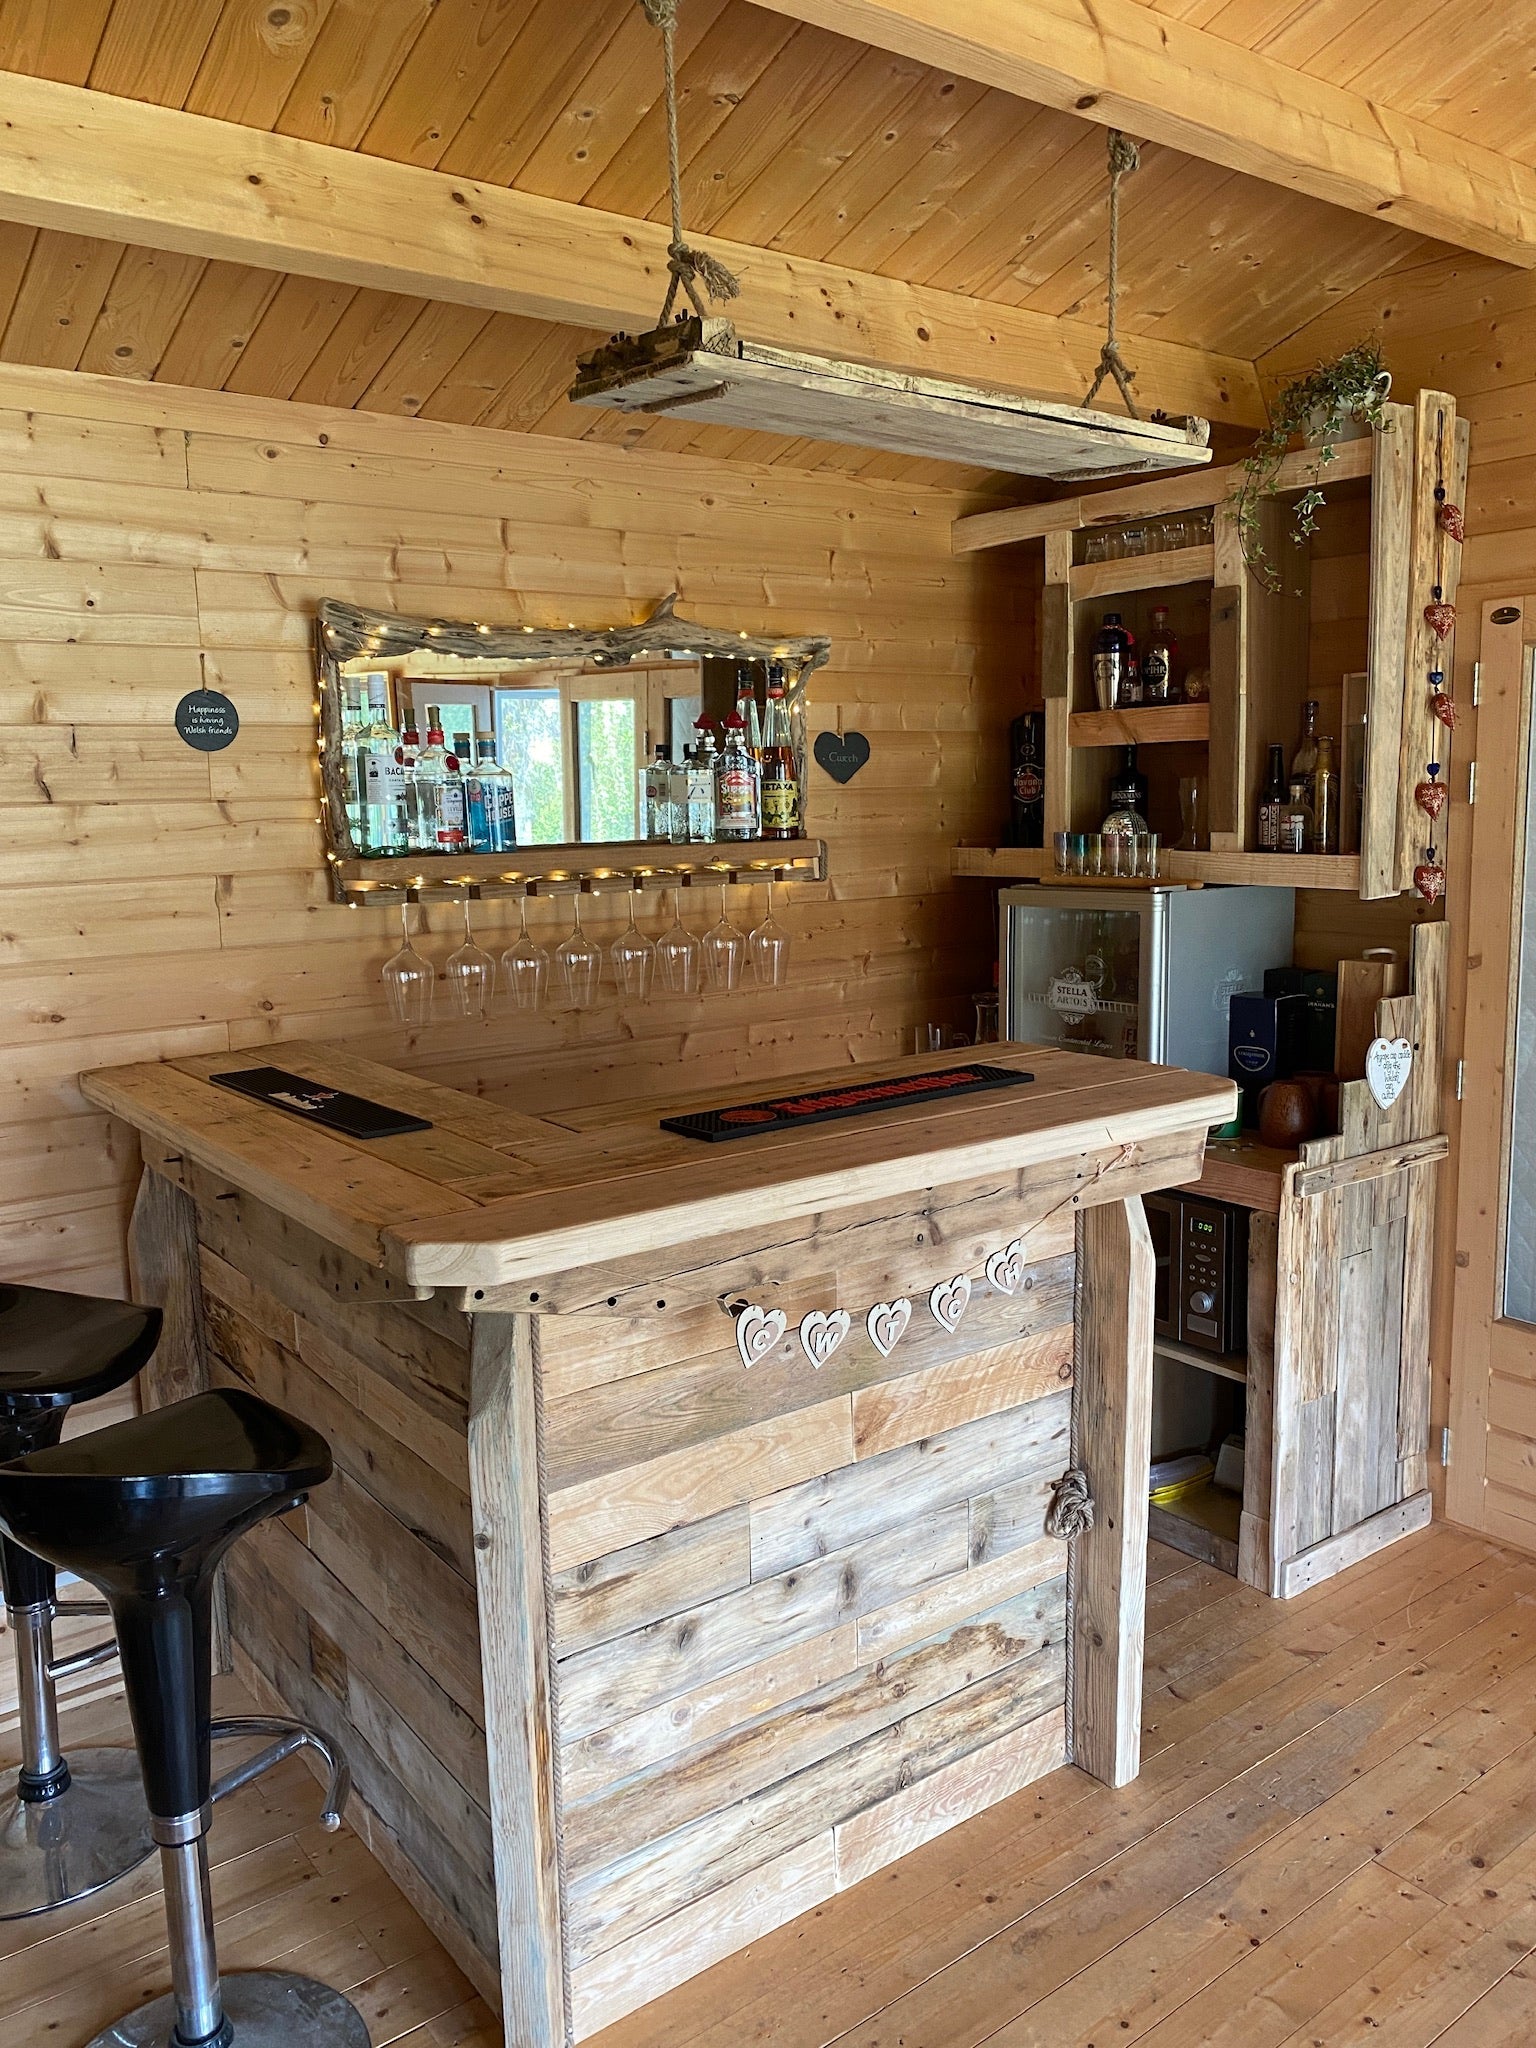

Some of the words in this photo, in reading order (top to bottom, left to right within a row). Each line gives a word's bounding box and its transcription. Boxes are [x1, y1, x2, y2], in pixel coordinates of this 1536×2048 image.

[188, 704, 226, 716] Happiness
[199, 717, 224, 726] having
[184, 726, 207, 734] Welsh
[208, 726, 233, 735] friends
[1019, 786, 1036, 795] Club
[1056, 985, 1088, 997] STELLA
